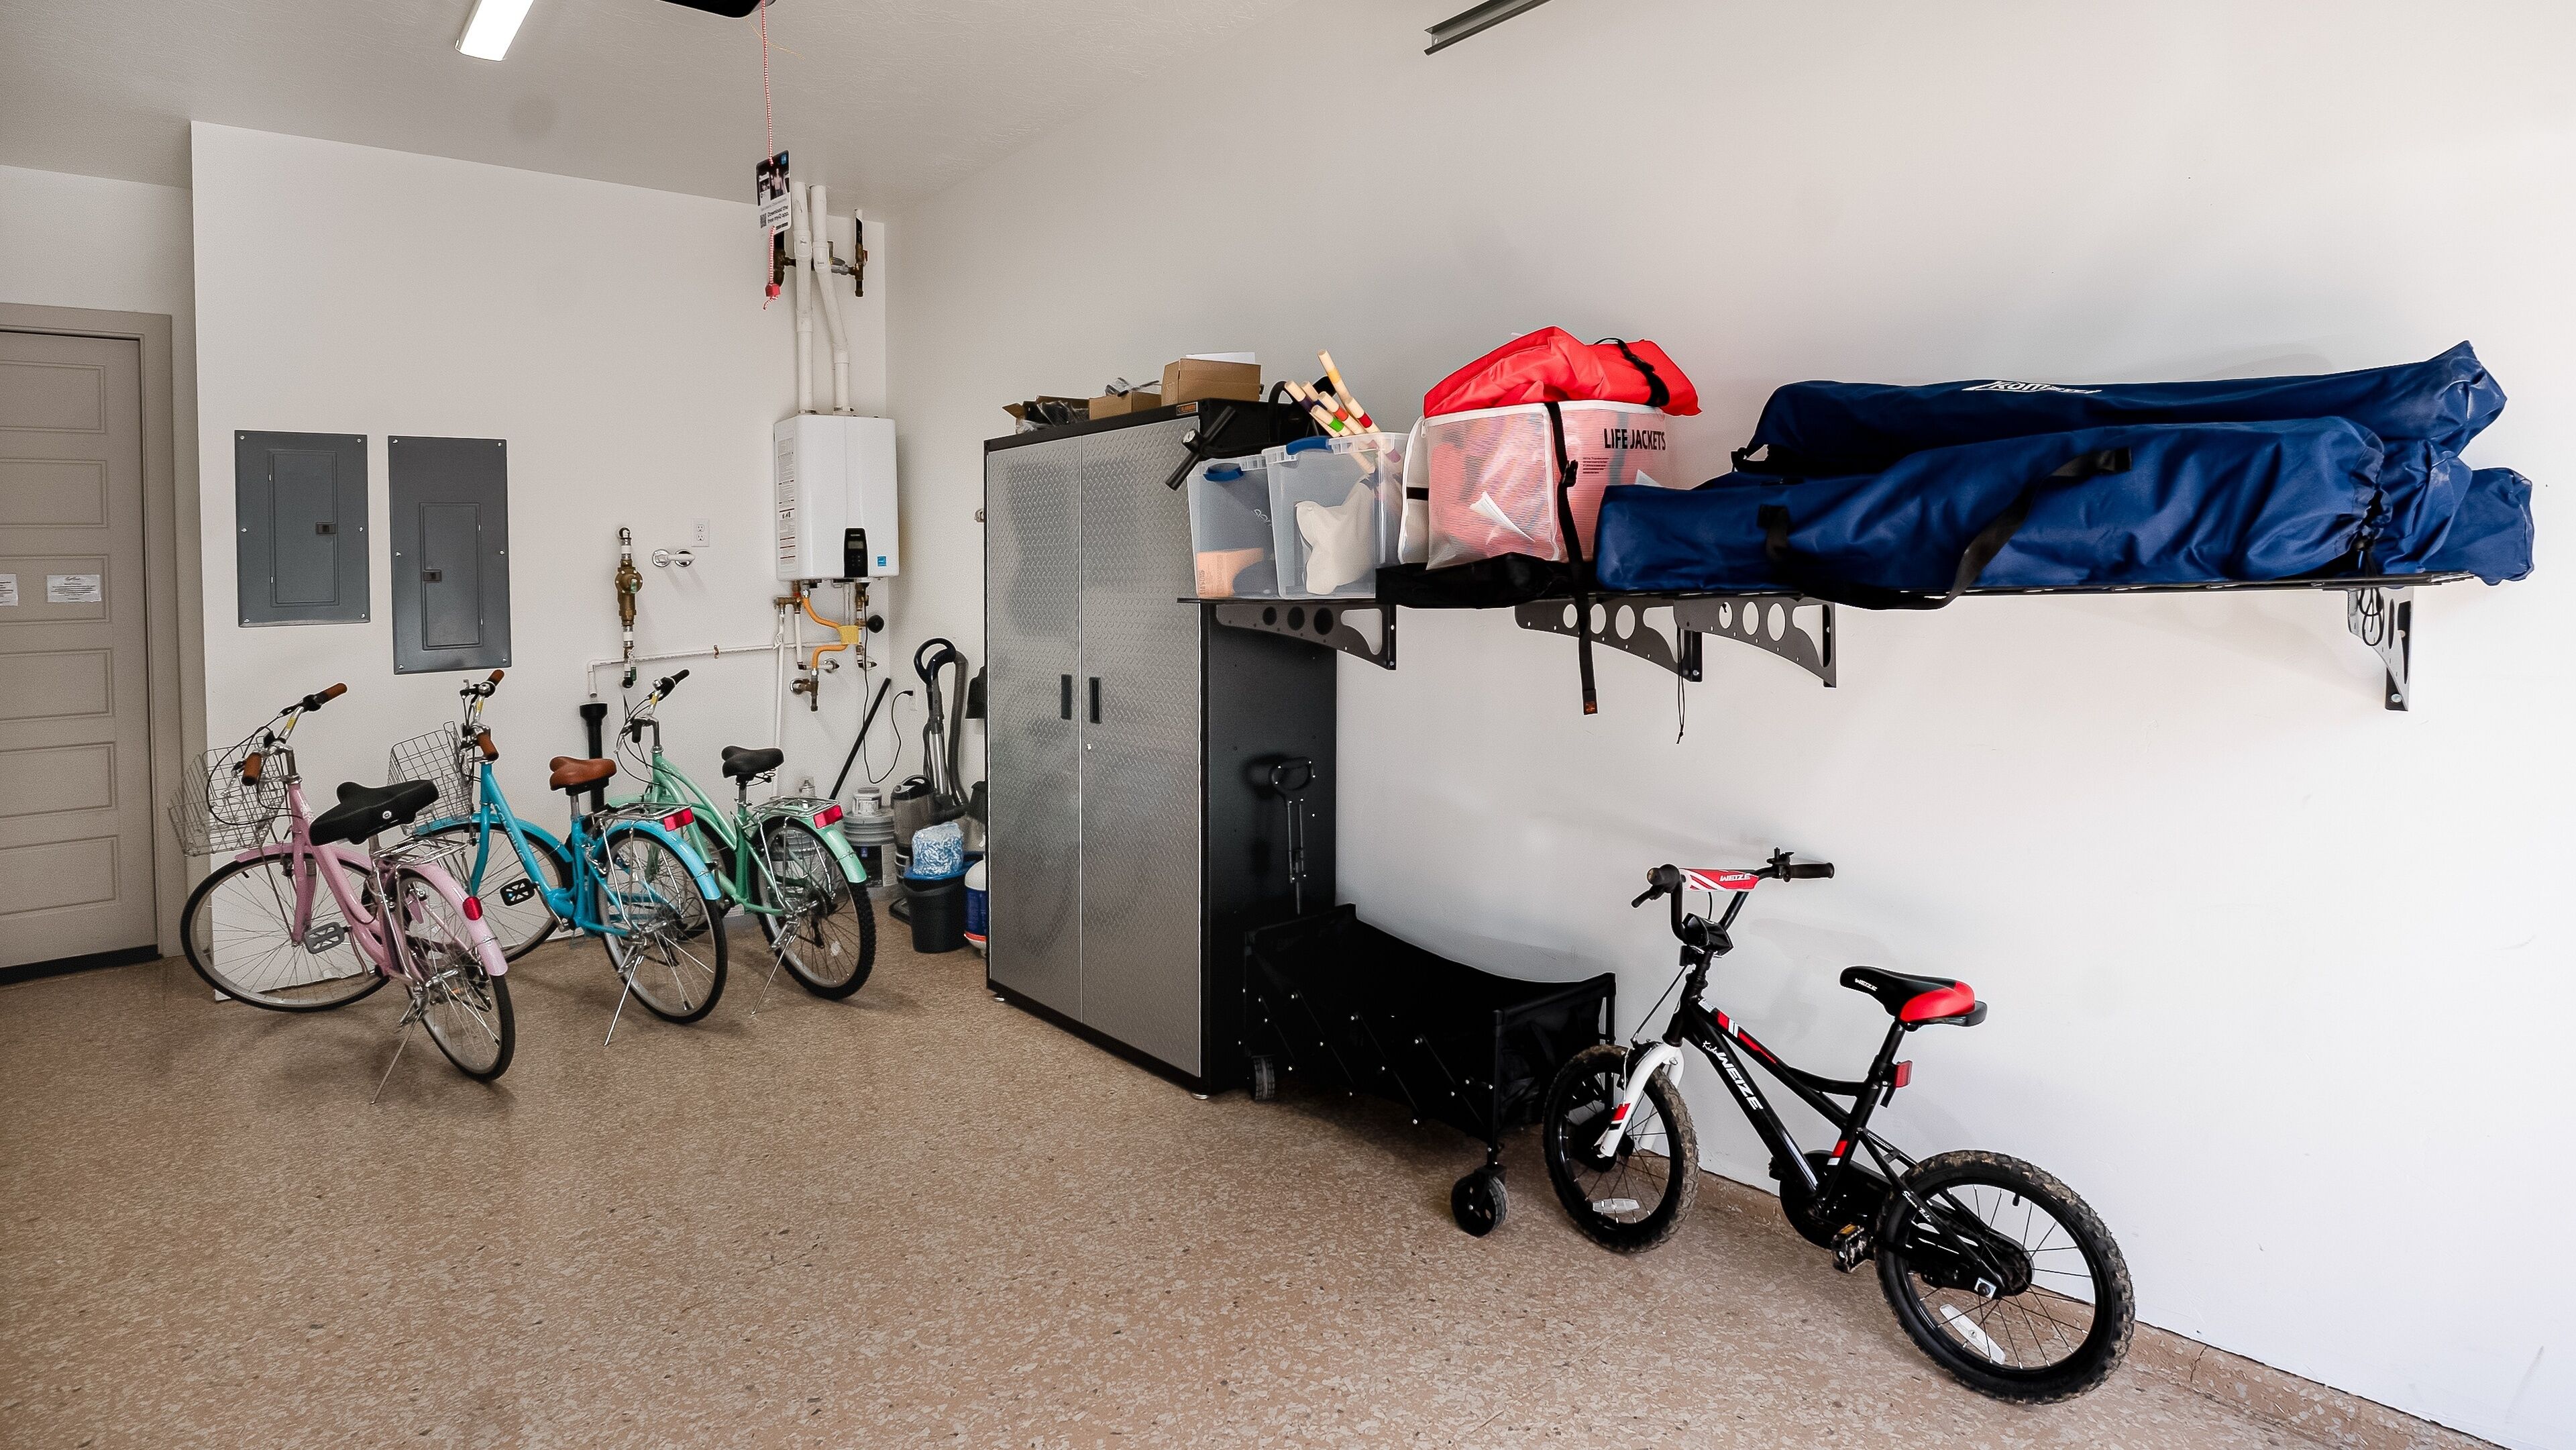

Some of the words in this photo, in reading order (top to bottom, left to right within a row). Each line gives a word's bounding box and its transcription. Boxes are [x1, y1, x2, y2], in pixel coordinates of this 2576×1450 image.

[1604, 428, 1628, 449] LIFE
[1630, 429, 1666, 450] JACKETS
[1719, 873, 1751, 882] WEIZE
[1715, 1052, 1764, 1110] WEIZE
